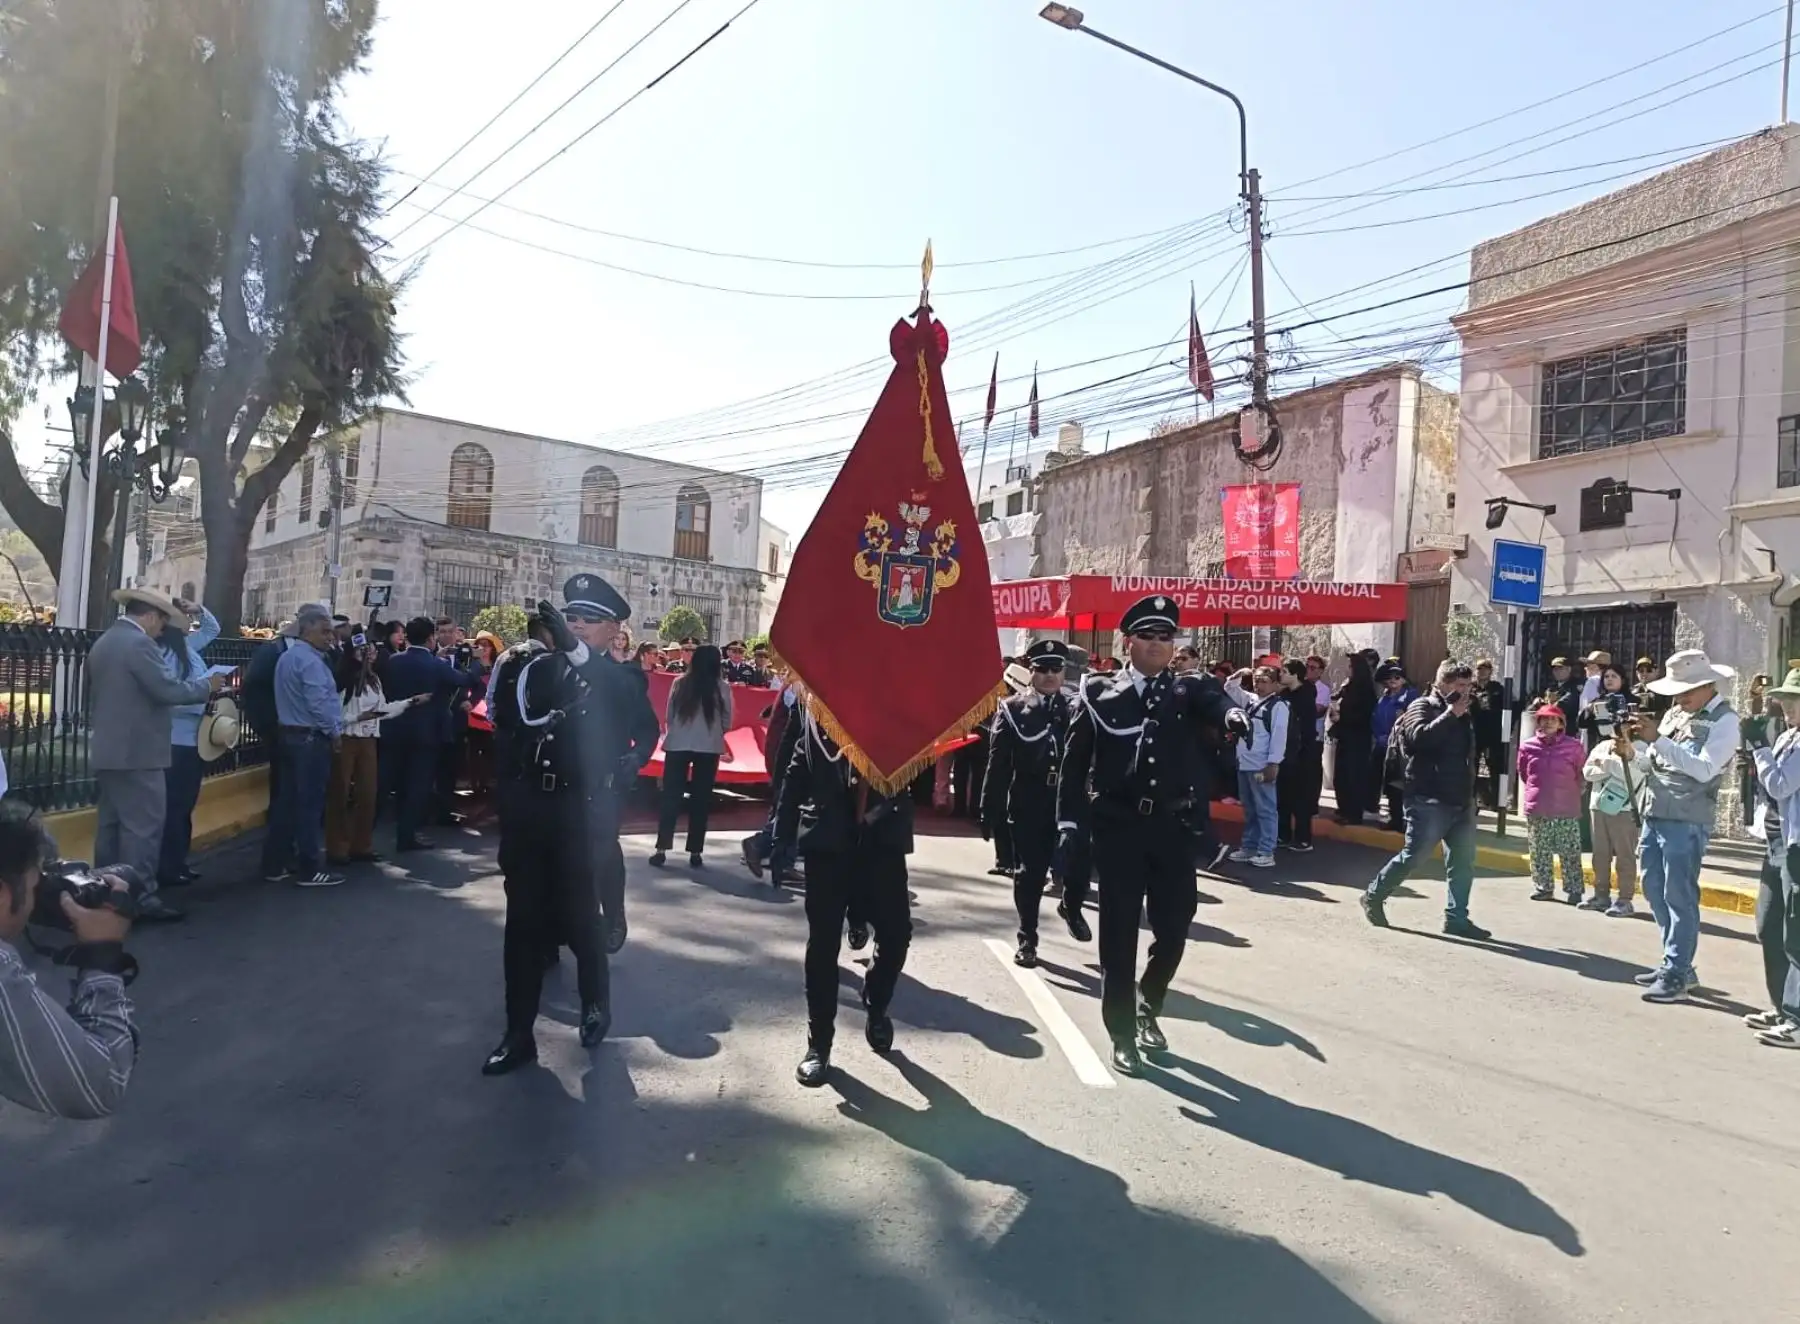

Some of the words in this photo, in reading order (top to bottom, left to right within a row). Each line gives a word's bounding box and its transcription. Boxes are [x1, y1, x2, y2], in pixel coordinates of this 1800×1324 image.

[1111, 575, 1266, 593] MUNICIPALIDAD
[1270, 579, 1382, 599] PROVINCIAL
[1172, 592, 1200, 609] DE
[1203, 593, 1302, 611] AREQUIPA
